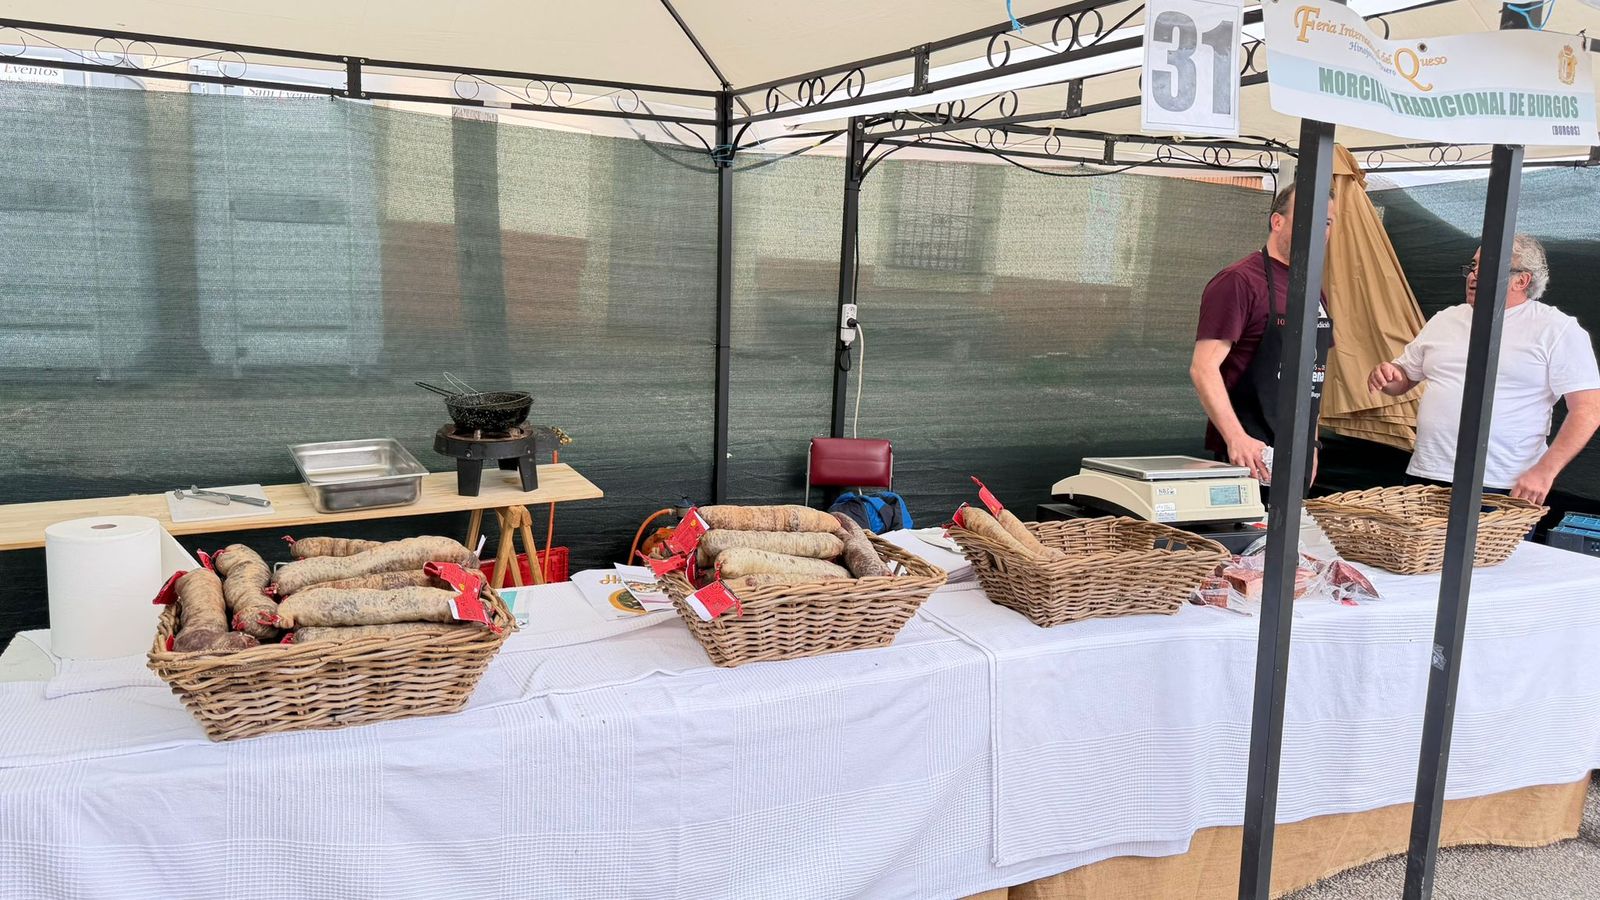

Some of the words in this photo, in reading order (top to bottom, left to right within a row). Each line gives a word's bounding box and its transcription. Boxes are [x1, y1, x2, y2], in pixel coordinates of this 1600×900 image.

[1294, 5, 1337, 43] Feria
[1394, 47, 1448, 92] Queso
[4, 63, 59, 77] Eventos
[1151, 10, 1234, 116] 31
[1391, 90, 1506, 118] TRADICIONAL
[1509, 92, 1525, 116] DE
[1527, 93, 1579, 118] BURGOS
[1551, 125, 1581, 136] (BURGOS)
